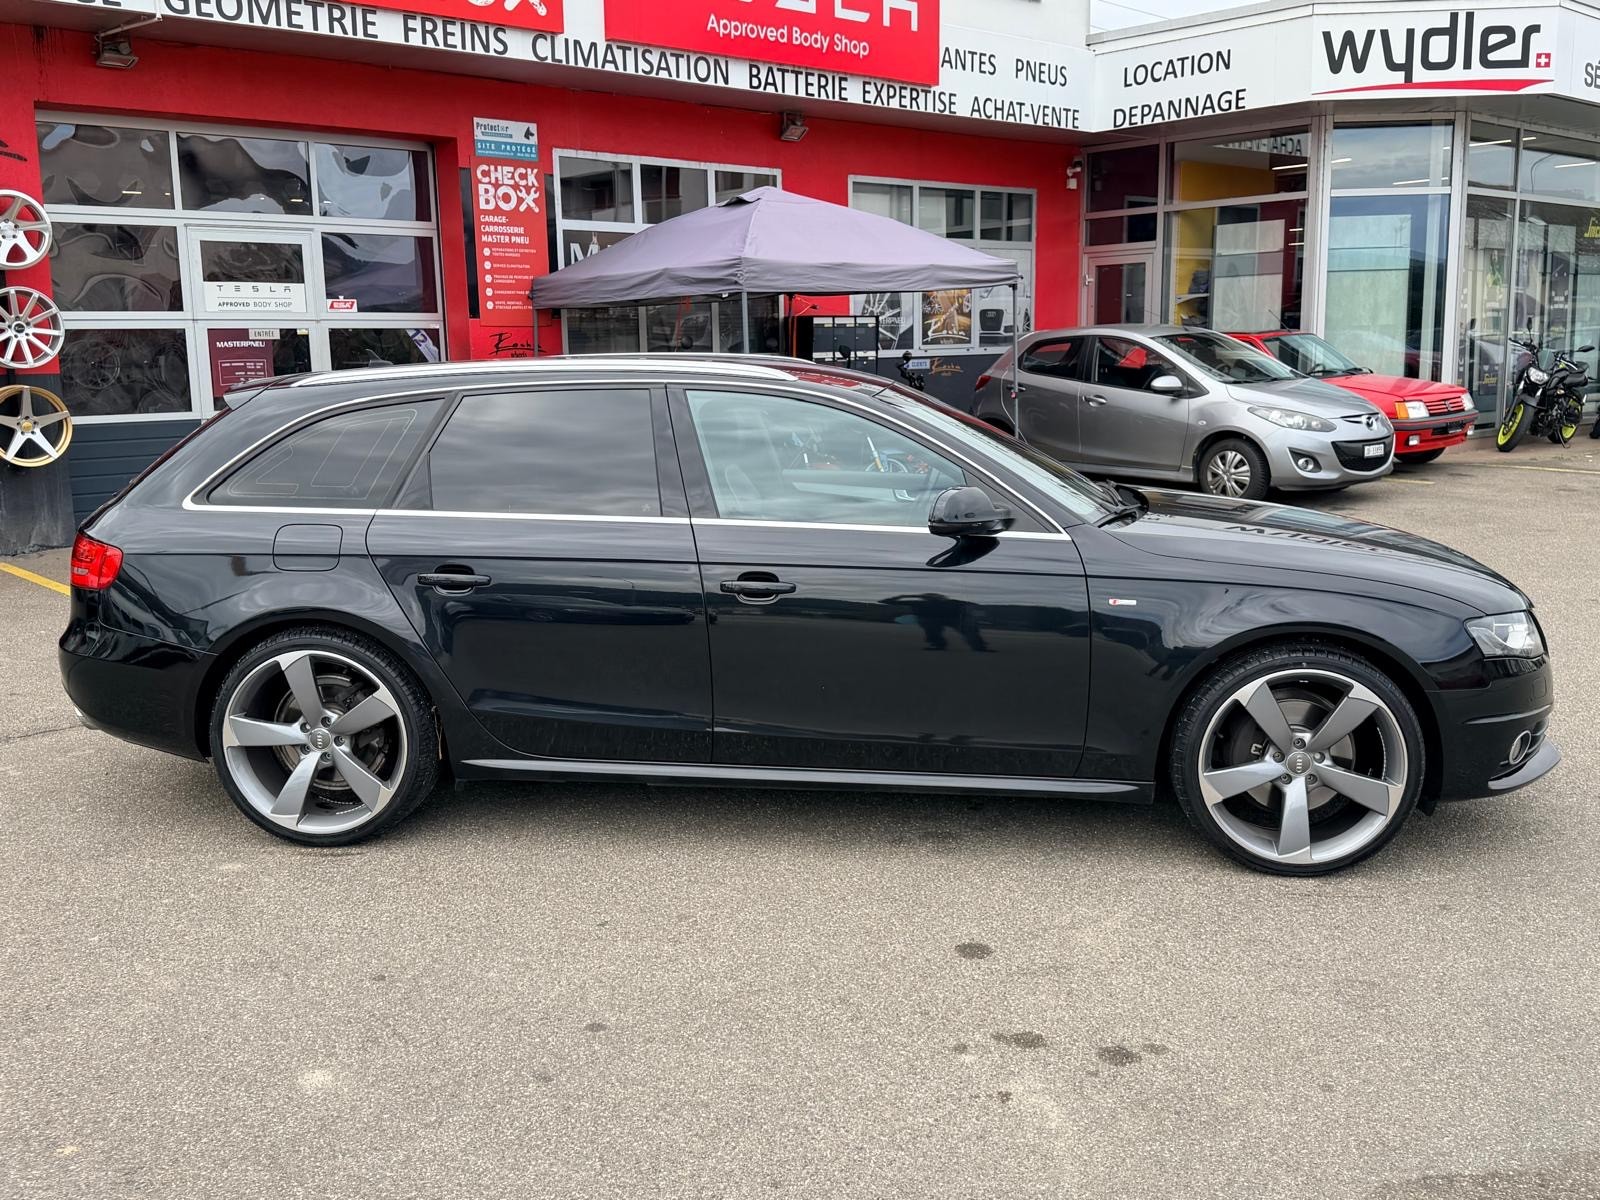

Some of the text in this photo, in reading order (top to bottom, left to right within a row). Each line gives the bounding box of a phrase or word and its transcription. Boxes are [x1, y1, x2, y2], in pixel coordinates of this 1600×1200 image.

[706, 13, 788, 44] Approved
[791, 26, 830, 53] Body
[833, 33, 870, 58] Shop
[1322, 11, 1542, 84] wydler
[402, 14, 509, 56] FREINS
[531, 33, 730, 86] CLIMATISATION
[748, 63, 849, 102] BATTERIE
[862, 80, 958, 115] EXPERTISE
[970, 96, 1081, 130] ACHAT-VENTE
[1015, 58, 1068, 88] PNEUS
[1123, 49, 1232, 89] LOCATION
[1113, 88, 1248, 130] DEPANNAGE
[476, 164, 539, 187] CHECK
[478, 183, 540, 213] BOX
[480, 224, 525, 234] CARROSSERIE
[481, 234, 530, 244] MASTER PNEU
[216, 284, 292, 293] TESLA
